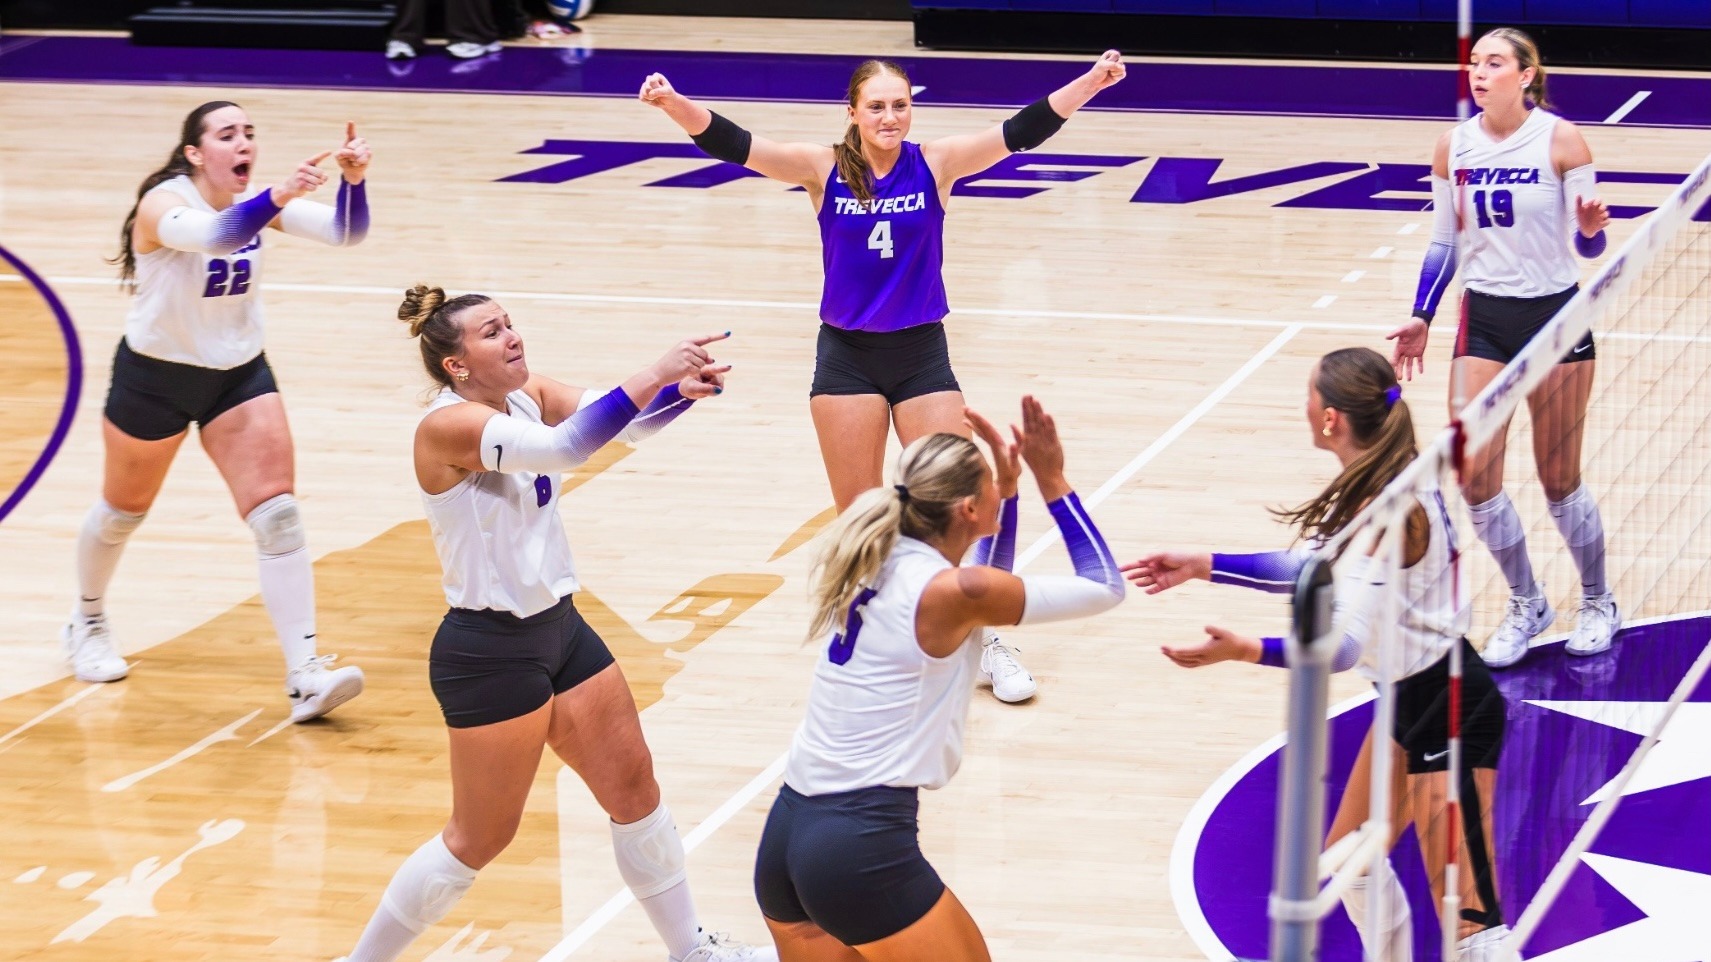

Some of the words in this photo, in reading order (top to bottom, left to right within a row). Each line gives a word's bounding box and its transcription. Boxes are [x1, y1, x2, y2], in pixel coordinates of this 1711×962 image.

[1454, 168, 1540, 186] TREVECCA
[835, 192, 926, 215] TREVECCA
[1473, 190, 1515, 229] 19
[868, 220, 894, 259] 4
[203, 258, 251, 298] 22
